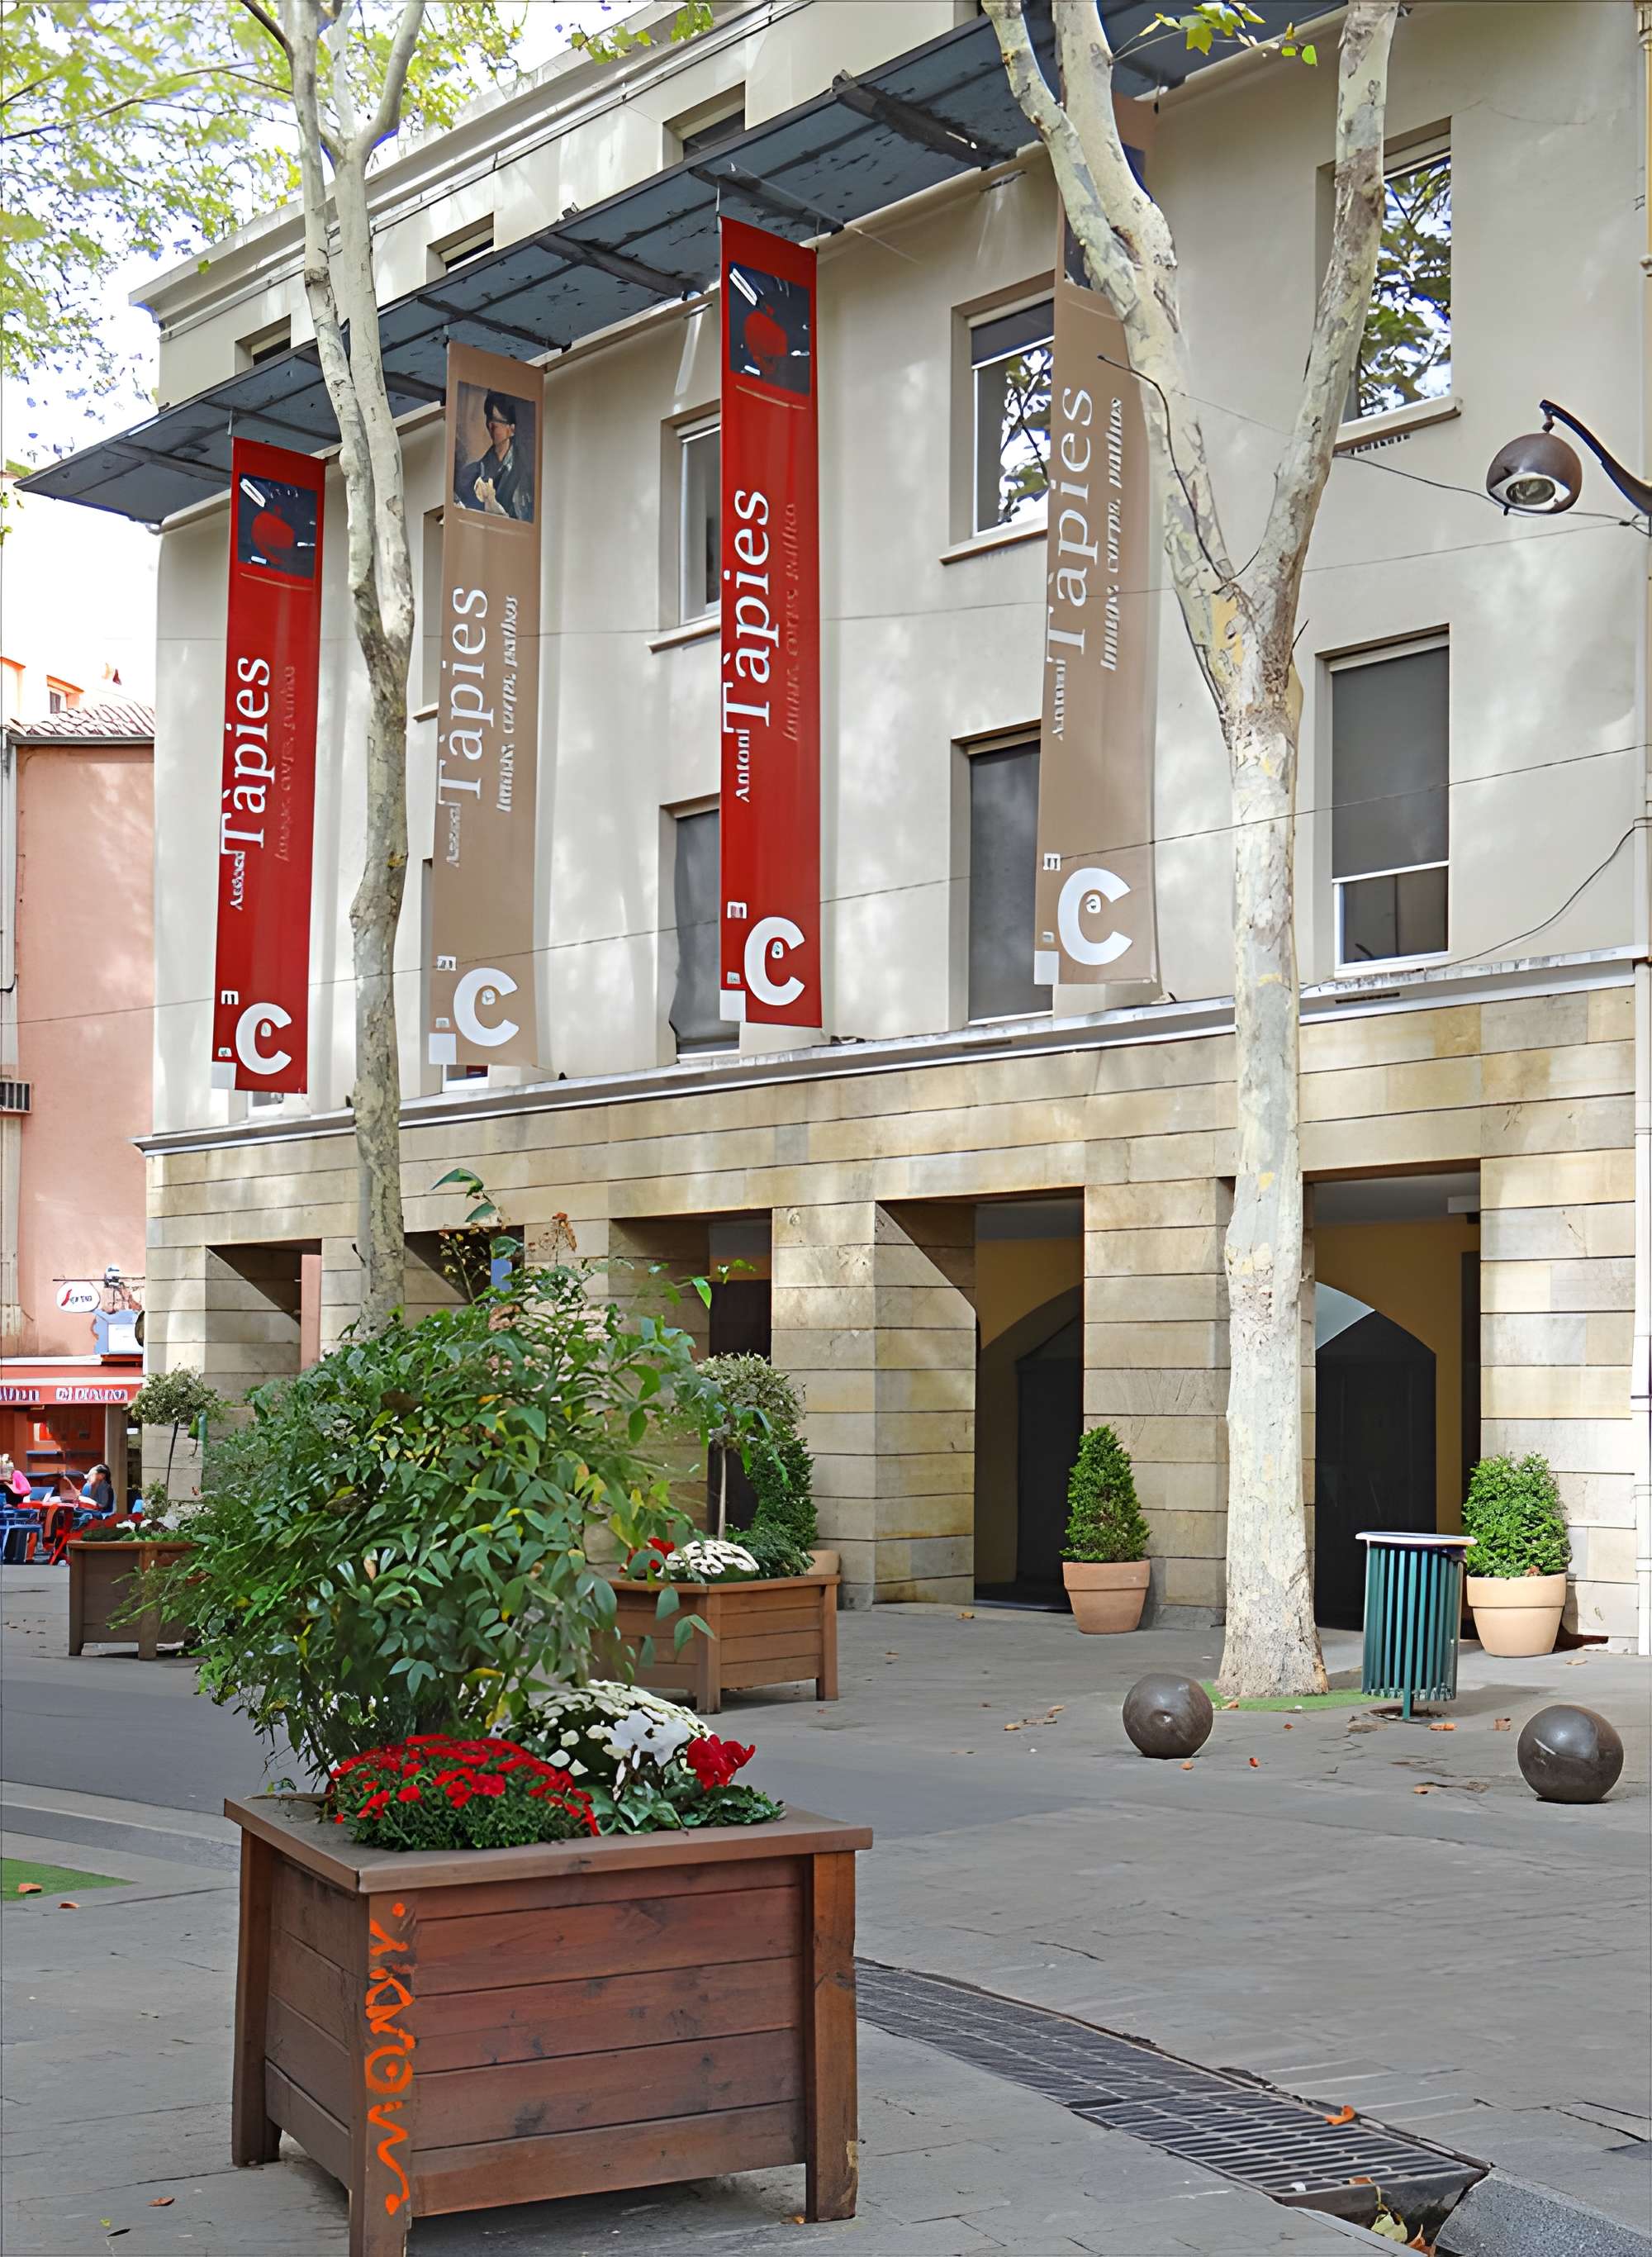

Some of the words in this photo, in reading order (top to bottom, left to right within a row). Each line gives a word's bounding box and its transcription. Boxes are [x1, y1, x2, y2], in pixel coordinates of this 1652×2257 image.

[722, 489, 780, 733] Tàpies
[1046, 387, 1099, 663] Tàpies
[220, 657, 275, 855] Tàpies
[437, 587, 494, 806] Tàpies
[735, 729, 750, 802] Antoni
